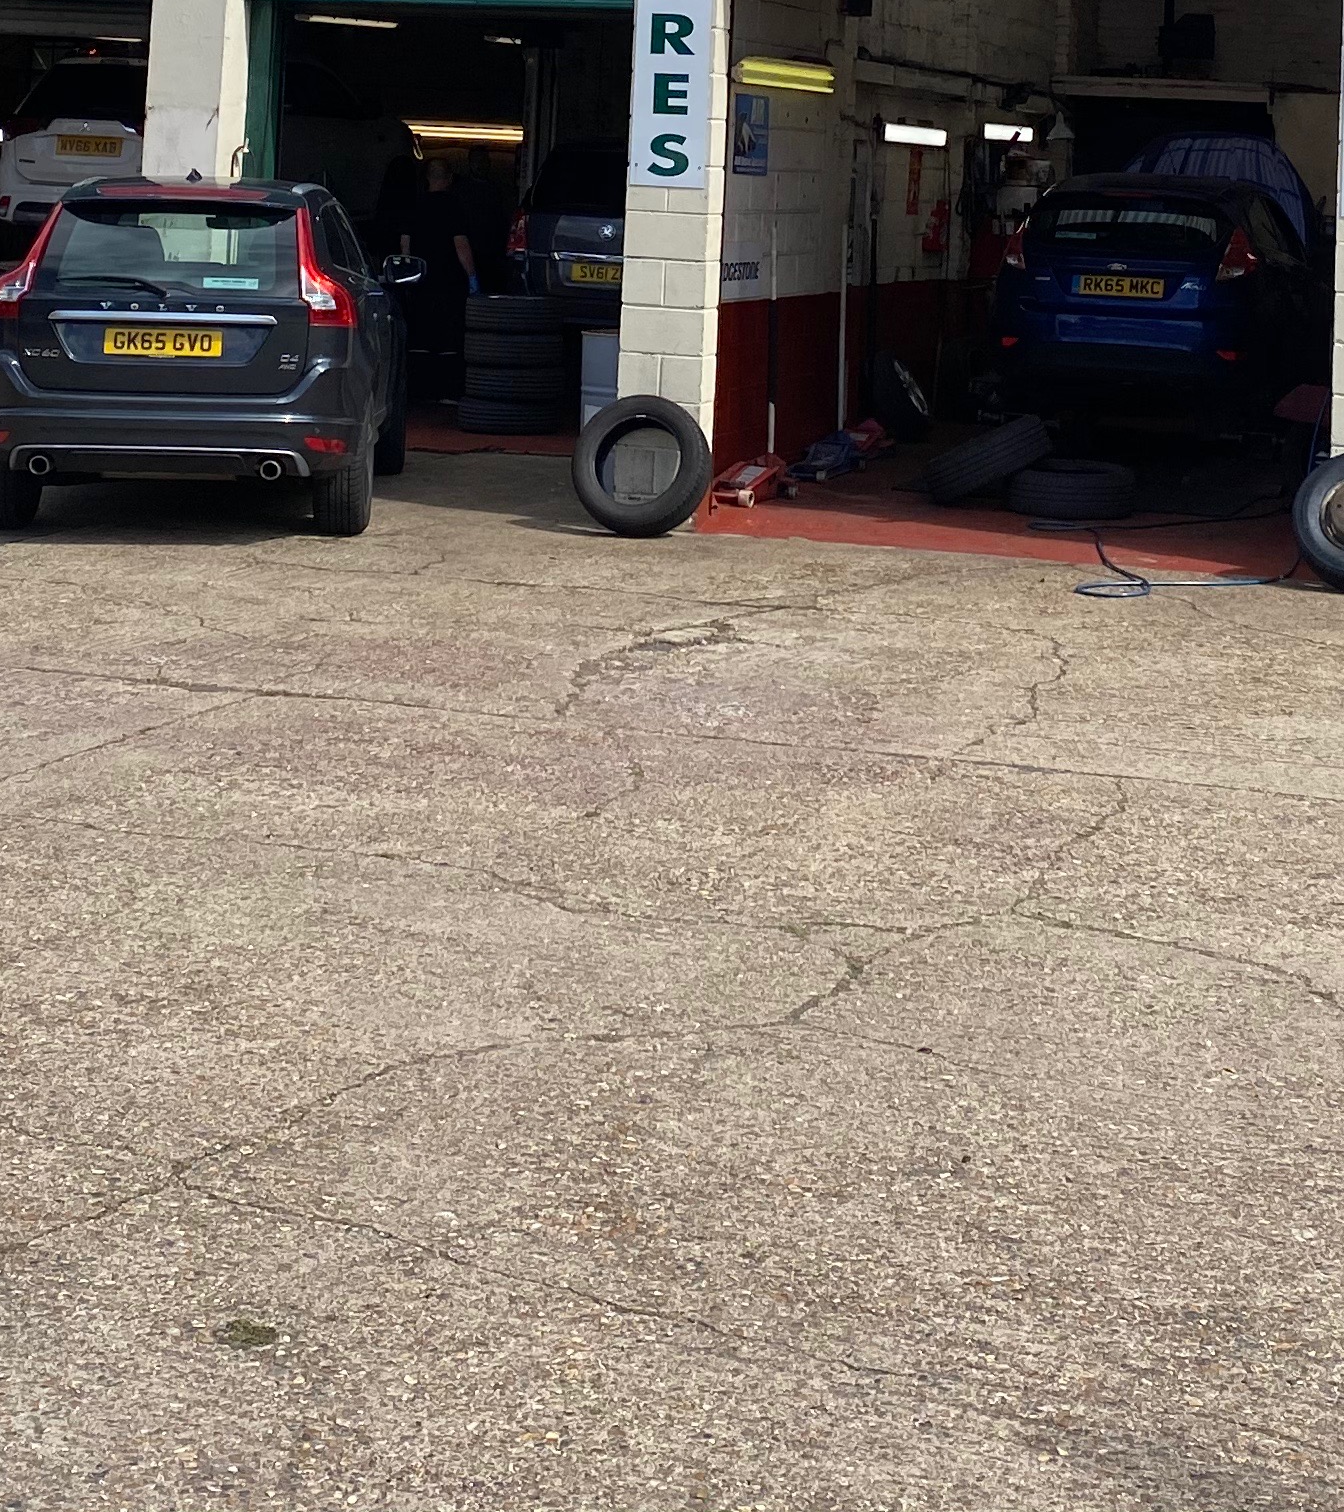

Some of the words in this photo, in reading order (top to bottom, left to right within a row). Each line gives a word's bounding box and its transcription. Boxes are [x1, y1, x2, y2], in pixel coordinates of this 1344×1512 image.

[579, 265, 608, 280] SV61
[1083, 277, 1125, 293] RK65
[1128, 279, 1161, 295] MKC
[100, 301, 226, 313] VOLVO
[113, 331, 167, 351] GK65
[172, 333, 213, 352] GVO
